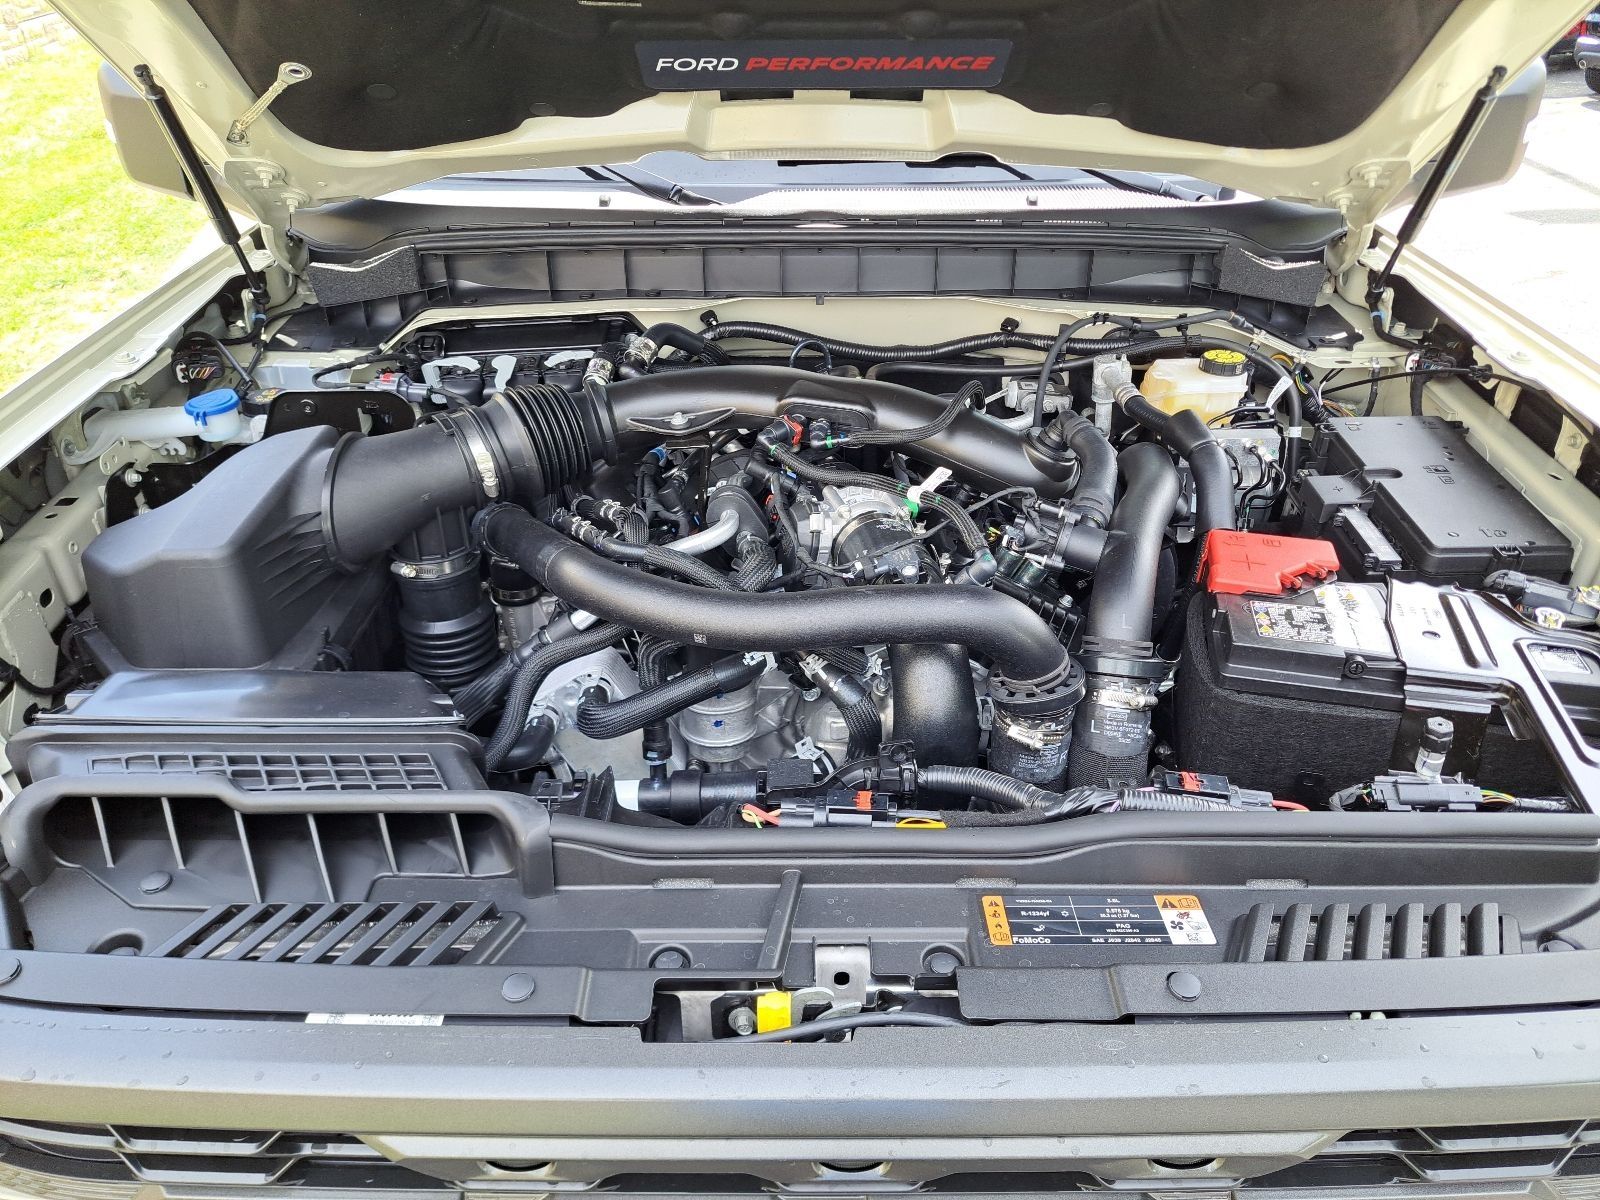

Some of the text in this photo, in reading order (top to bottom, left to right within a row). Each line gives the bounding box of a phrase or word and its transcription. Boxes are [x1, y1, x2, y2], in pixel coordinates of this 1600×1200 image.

[655, 56, 996, 72] FORD PERFORMANCE
[1091, 720, 1100, 733] L
[1012, 936, 1051, 944] FoMoCo
